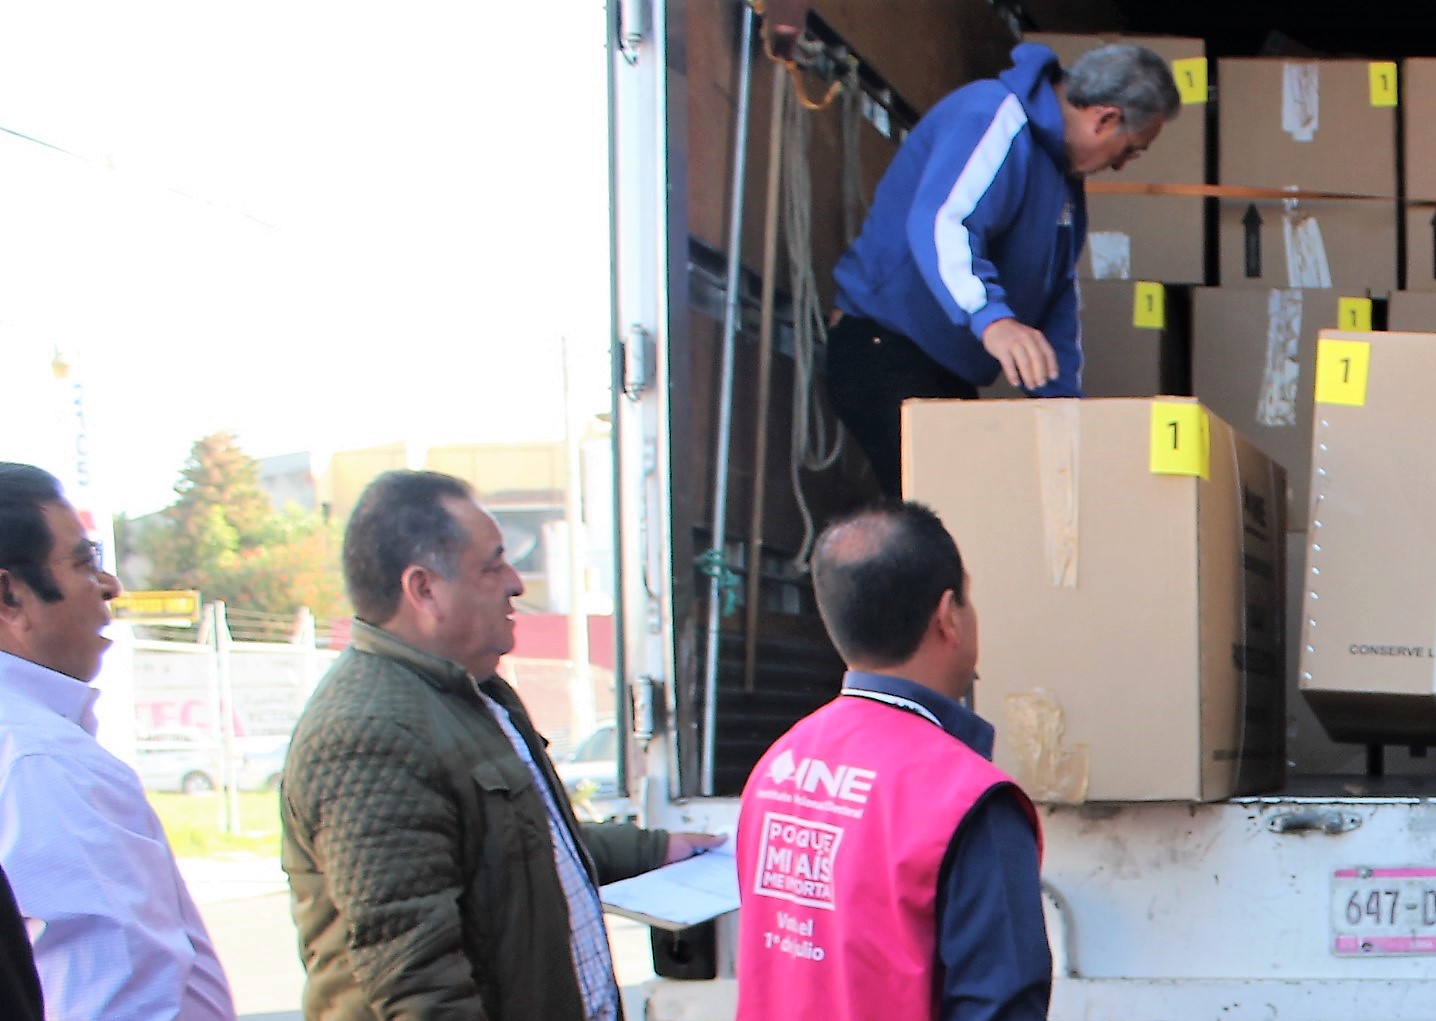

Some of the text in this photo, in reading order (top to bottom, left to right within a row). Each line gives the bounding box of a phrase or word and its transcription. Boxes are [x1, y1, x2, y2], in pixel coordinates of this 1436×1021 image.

[1379, 73, 1389, 92] 1
[1349, 309, 1358, 328] 1
[1339, 356, 1352, 384] 1
[1167, 421, 1179, 450] 1
[1350, 643, 1424, 658] CONSERVE
[796, 757, 878, 805] INE
[766, 845, 832, 883] MI AÍS
